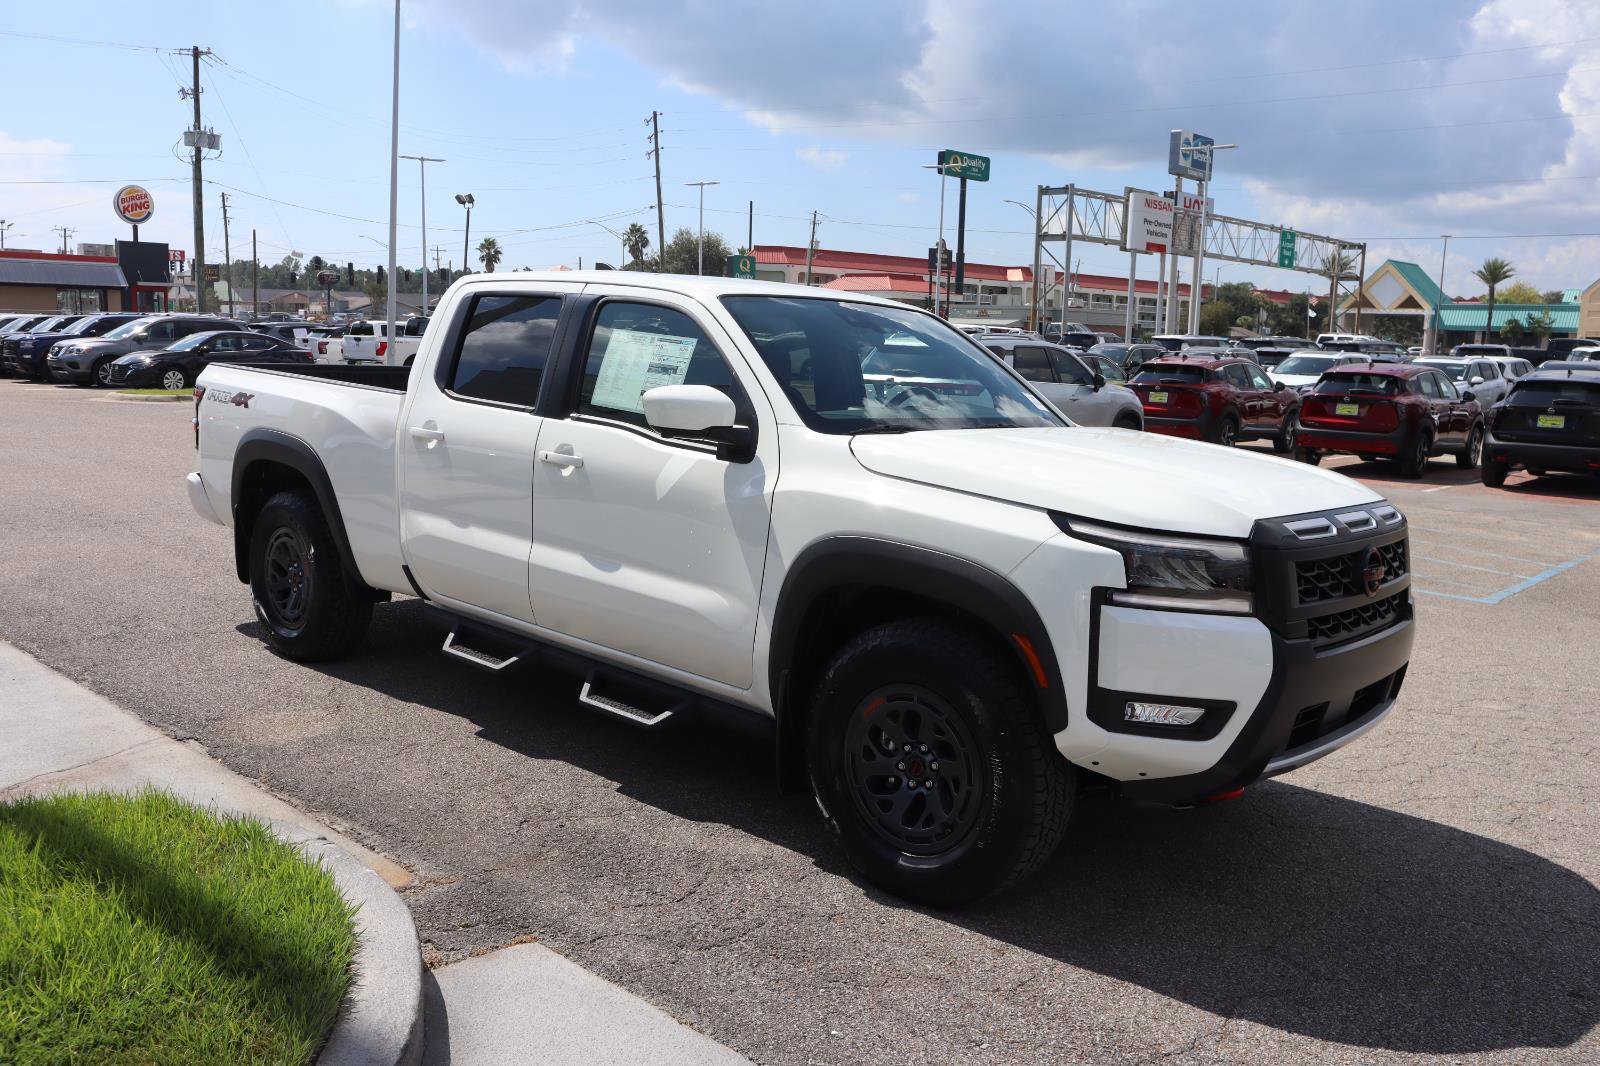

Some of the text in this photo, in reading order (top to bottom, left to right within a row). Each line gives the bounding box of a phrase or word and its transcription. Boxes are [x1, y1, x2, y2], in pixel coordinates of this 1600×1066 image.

[963, 156, 986, 171] Quality
[120, 193, 149, 206] BURGER
[1144, 197, 1173, 213] NISSAN
[121, 200, 150, 215] KING
[1143, 217, 1172, 230] Pre-Owned
[1146, 228, 1168, 239] Vehicles
